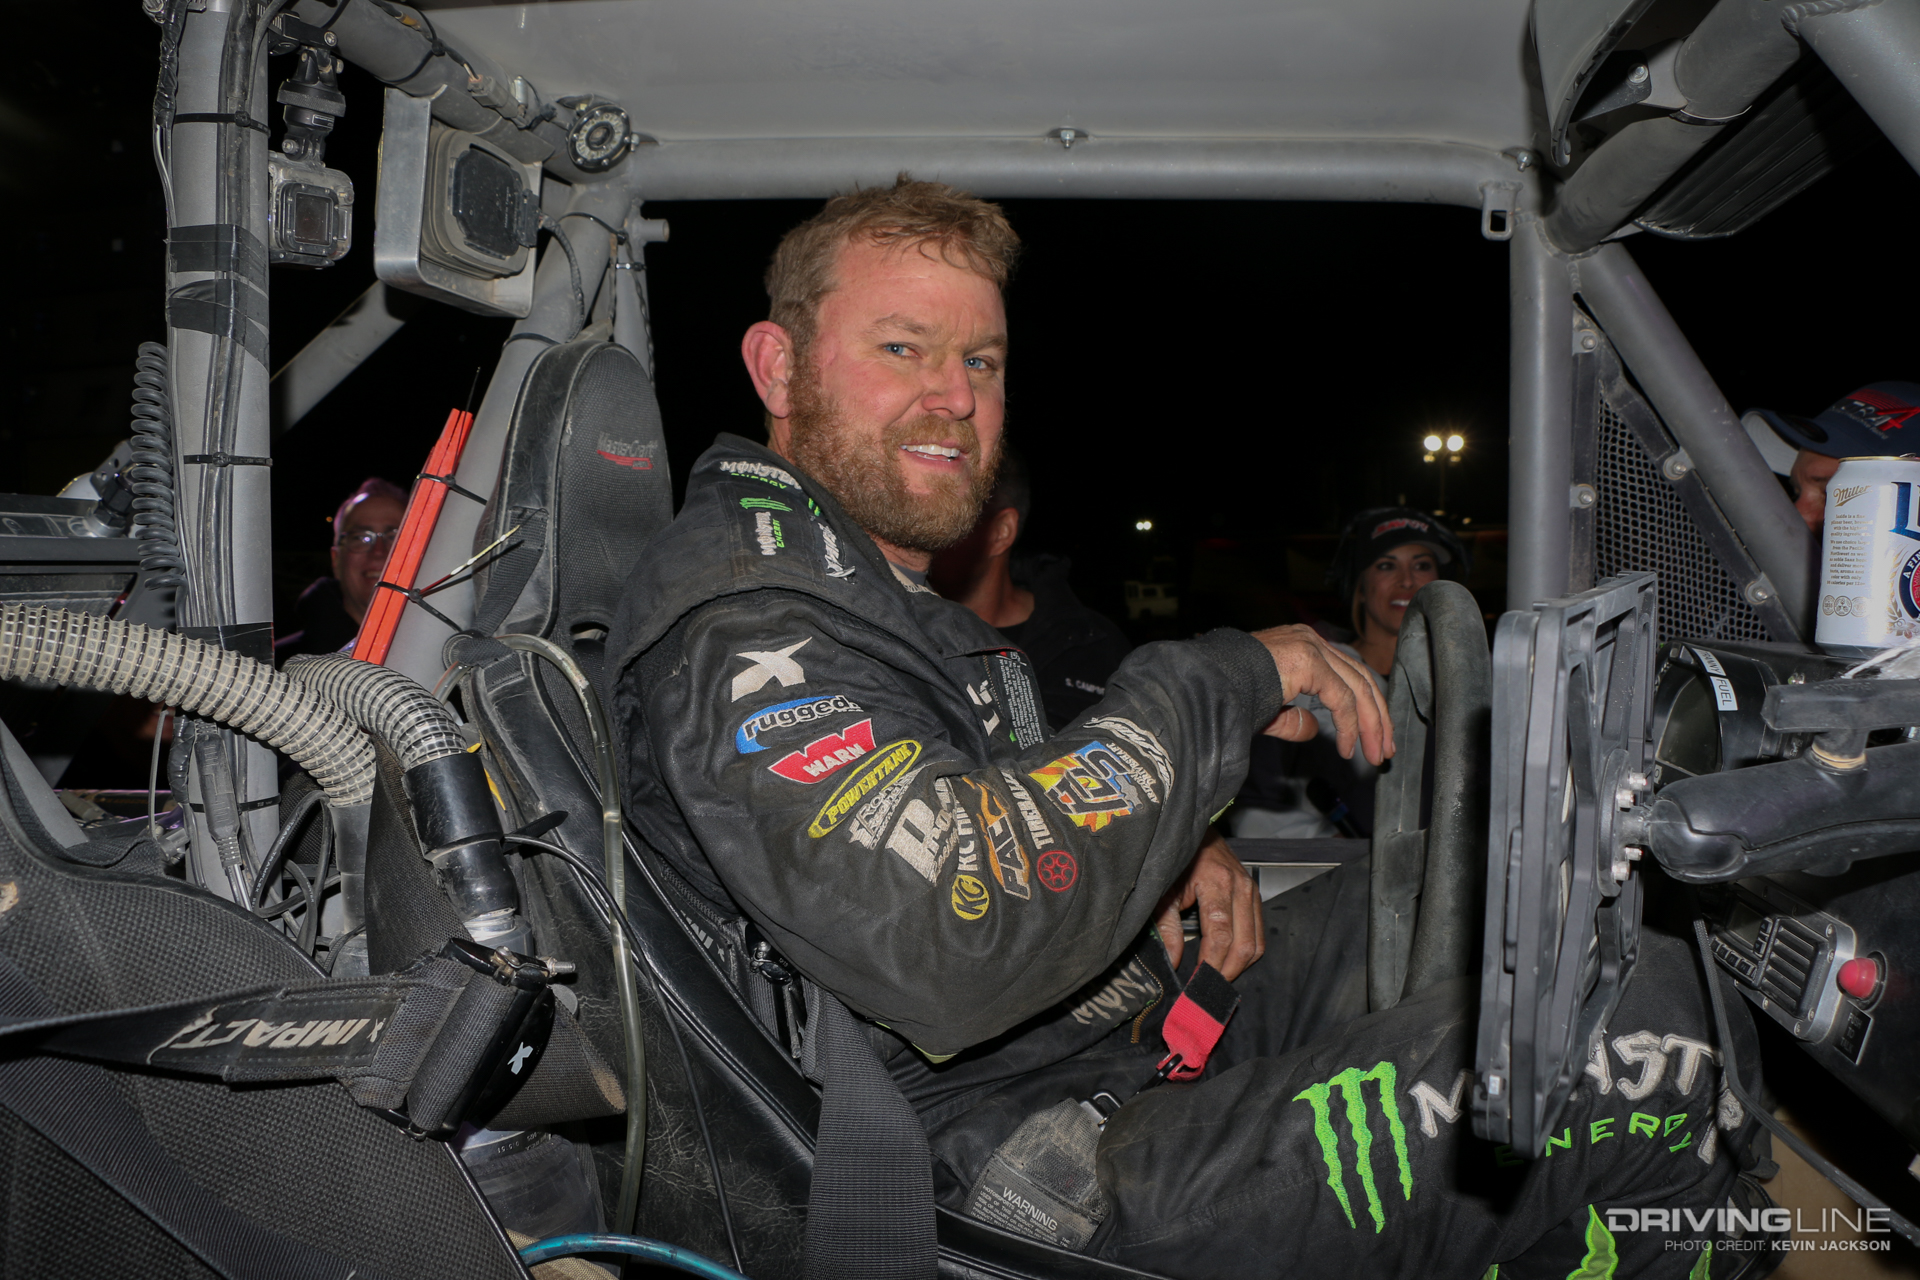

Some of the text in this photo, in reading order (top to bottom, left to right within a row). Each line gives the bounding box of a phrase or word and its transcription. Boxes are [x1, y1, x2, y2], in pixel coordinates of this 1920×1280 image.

[1833, 485, 1872, 507] Miller
[1903, 571, 1911, 579] A
[1717, 679, 1732, 706] FUEL
[802, 743, 866, 777] WARN
[825, 743, 913, 825] POWERTANK
[955, 876, 988, 916] KC
[169, 1017, 370, 1049] IMPACT
[1846, 1026, 1854, 1038] TO
[1847, 1012, 1862, 1029] PUSH
[1002, 1186, 1059, 1232] WARNING
